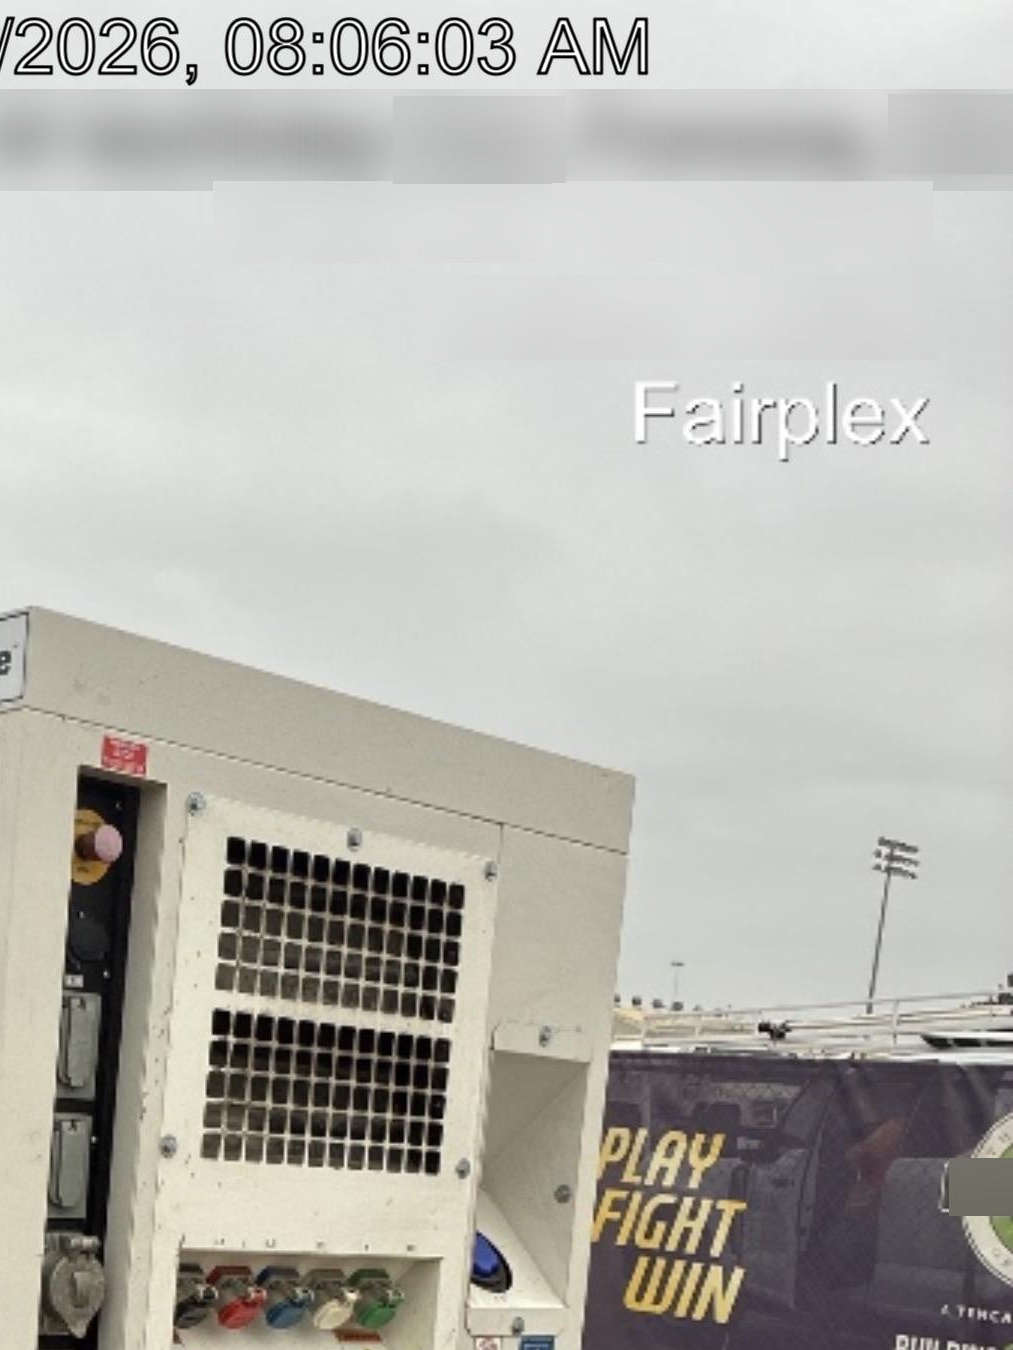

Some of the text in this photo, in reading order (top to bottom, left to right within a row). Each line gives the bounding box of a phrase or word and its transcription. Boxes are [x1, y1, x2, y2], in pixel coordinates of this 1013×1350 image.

[597, 1127, 726, 1189] PLAY
[591, 1188, 747, 1258] FIGHT
[623, 1255, 746, 1324] WIN
